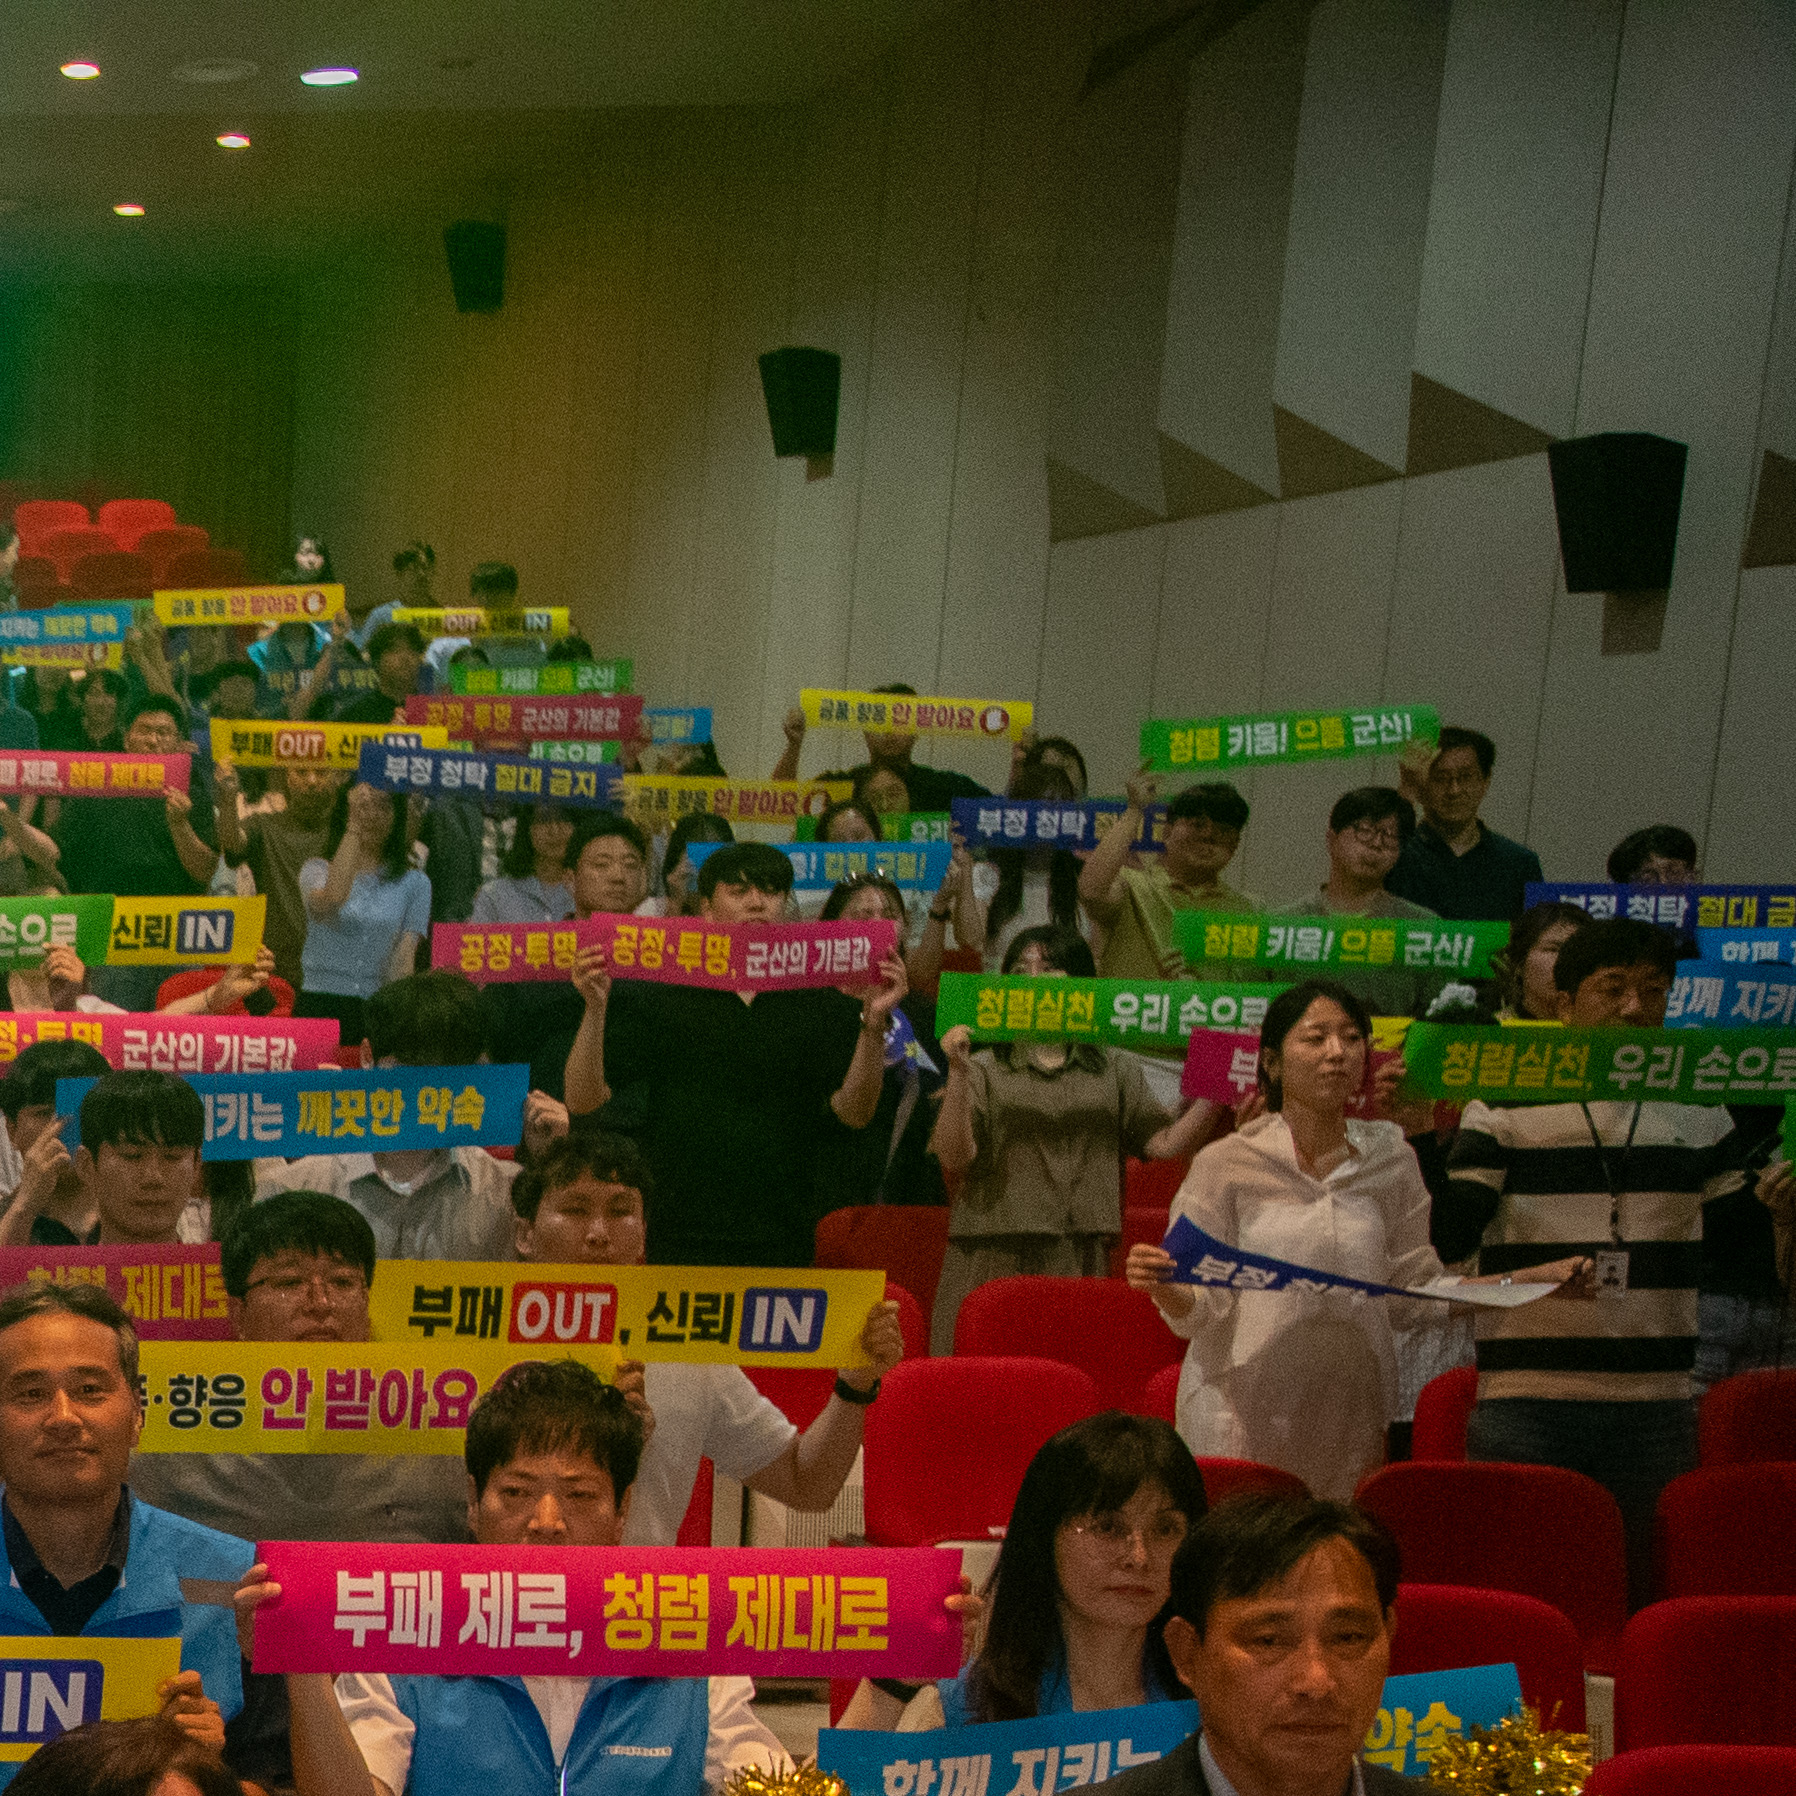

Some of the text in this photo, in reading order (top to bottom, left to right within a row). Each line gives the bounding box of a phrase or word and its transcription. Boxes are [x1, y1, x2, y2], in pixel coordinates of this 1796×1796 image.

[522, 705, 621, 732] 군산의 기본값
[916, 703, 975, 729] 받아요
[1227, 713, 1412, 755] 키움! 으뜸 군산!
[384, 754, 598, 798] 부정 청탁 절대 금지
[977, 807, 1086, 839] 부정 청탁
[182, 913, 229, 950] IN
[1204, 923, 1475, 968] 청렴 키움! 으뜸 군산!
[746, 936, 872, 978] 군산의 기본값
[1109, 991, 1170, 1034] 우리
[122, 1028, 298, 1072] 군산의 기본값
[1608, 1043, 1685, 1091] 우리
[296, 1084, 487, 1138] 깨끗한 약속
[408, 1285, 504, 1337] 부패
[645, 1292, 735, 1345] 신뢰
[749, 1295, 816, 1346] IN
[259, 1367, 477, 1433] 안 받아요
[332, 1570, 892, 1660] 부패 제로, 청렴 제대로
[0, 1672, 86, 1735] IN
